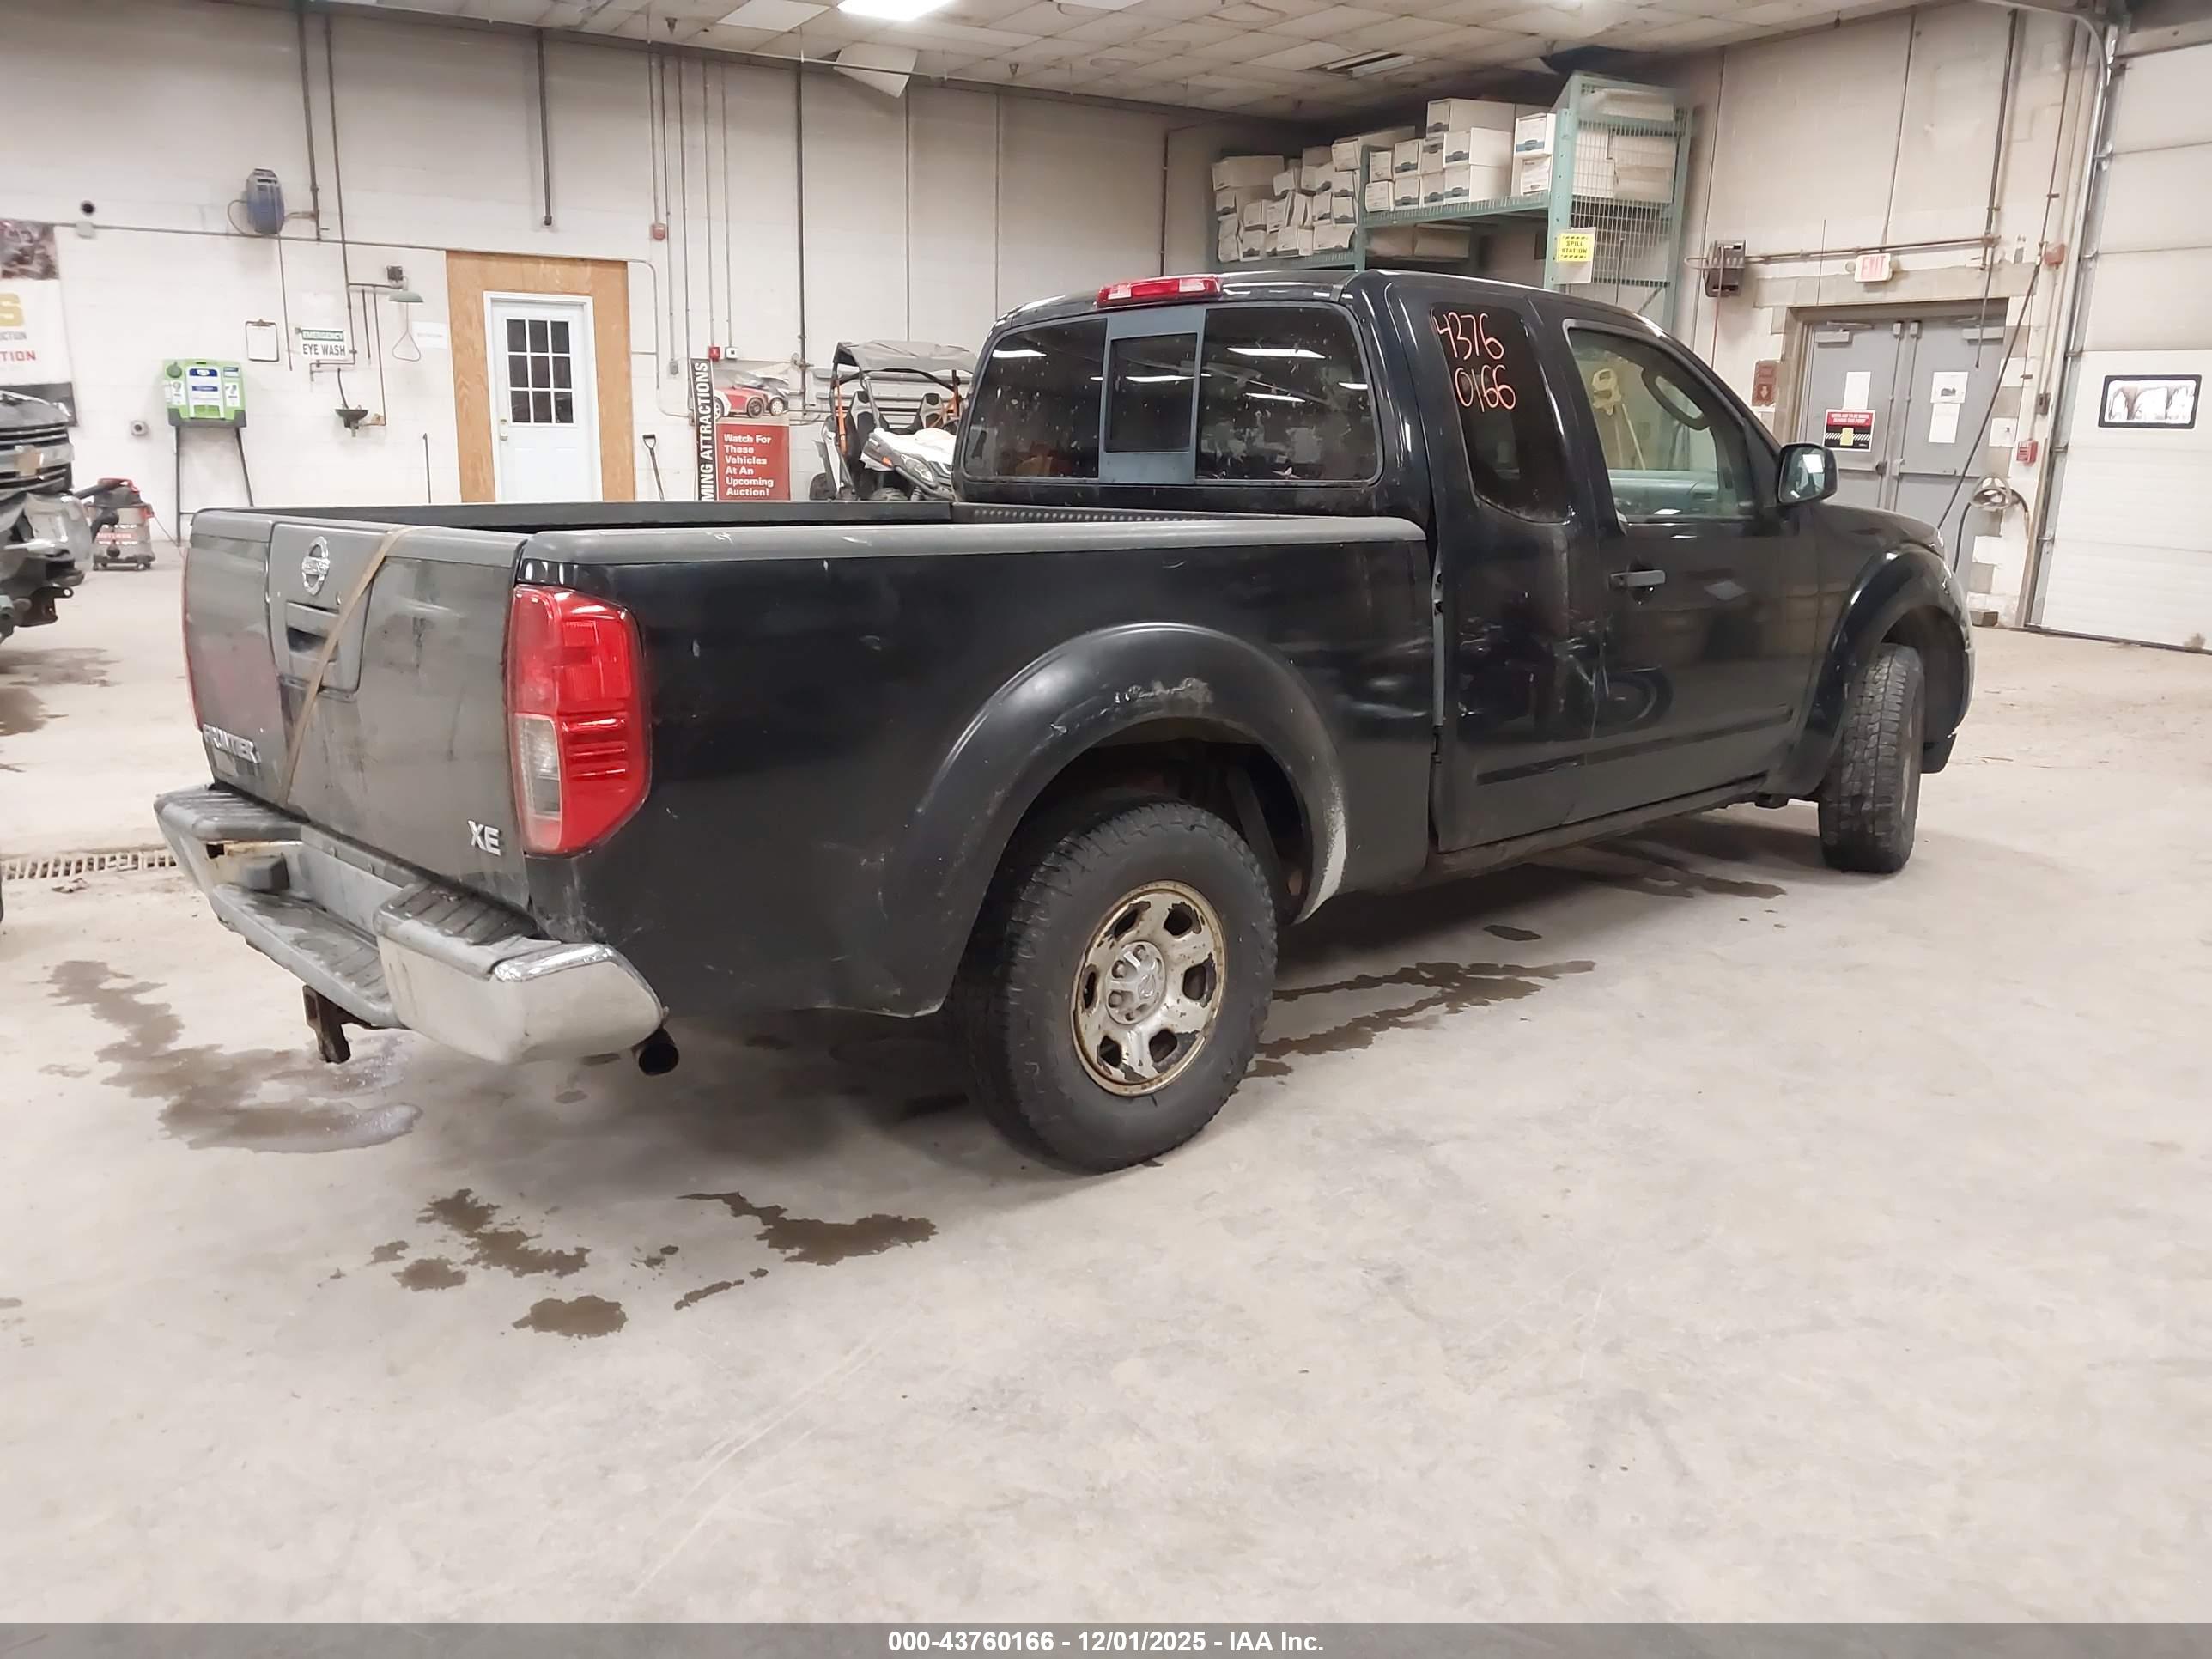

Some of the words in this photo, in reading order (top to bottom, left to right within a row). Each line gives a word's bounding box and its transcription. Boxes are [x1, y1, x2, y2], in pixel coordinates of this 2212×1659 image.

[1862, 256, 1886, 279] EXIT
[1432, 312, 1504, 360] 4376
[302, 343, 319, 355] EYE
[321, 344, 345, 356] WASH
[1455, 364, 1516, 413] 0166
[695, 362, 713, 460] ATTRACTIONS
[724, 434, 753, 443] Watch
[756, 434, 771, 443] For
[724, 445, 754, 453] These
[725, 455, 767, 465] Vehicles
[726, 466, 737, 475] At
[739, 466, 754, 475] An
[726, 477, 774, 488] Upcoming
[726, 487, 769, 496] Auction!
[467, 820, 501, 856] XE
